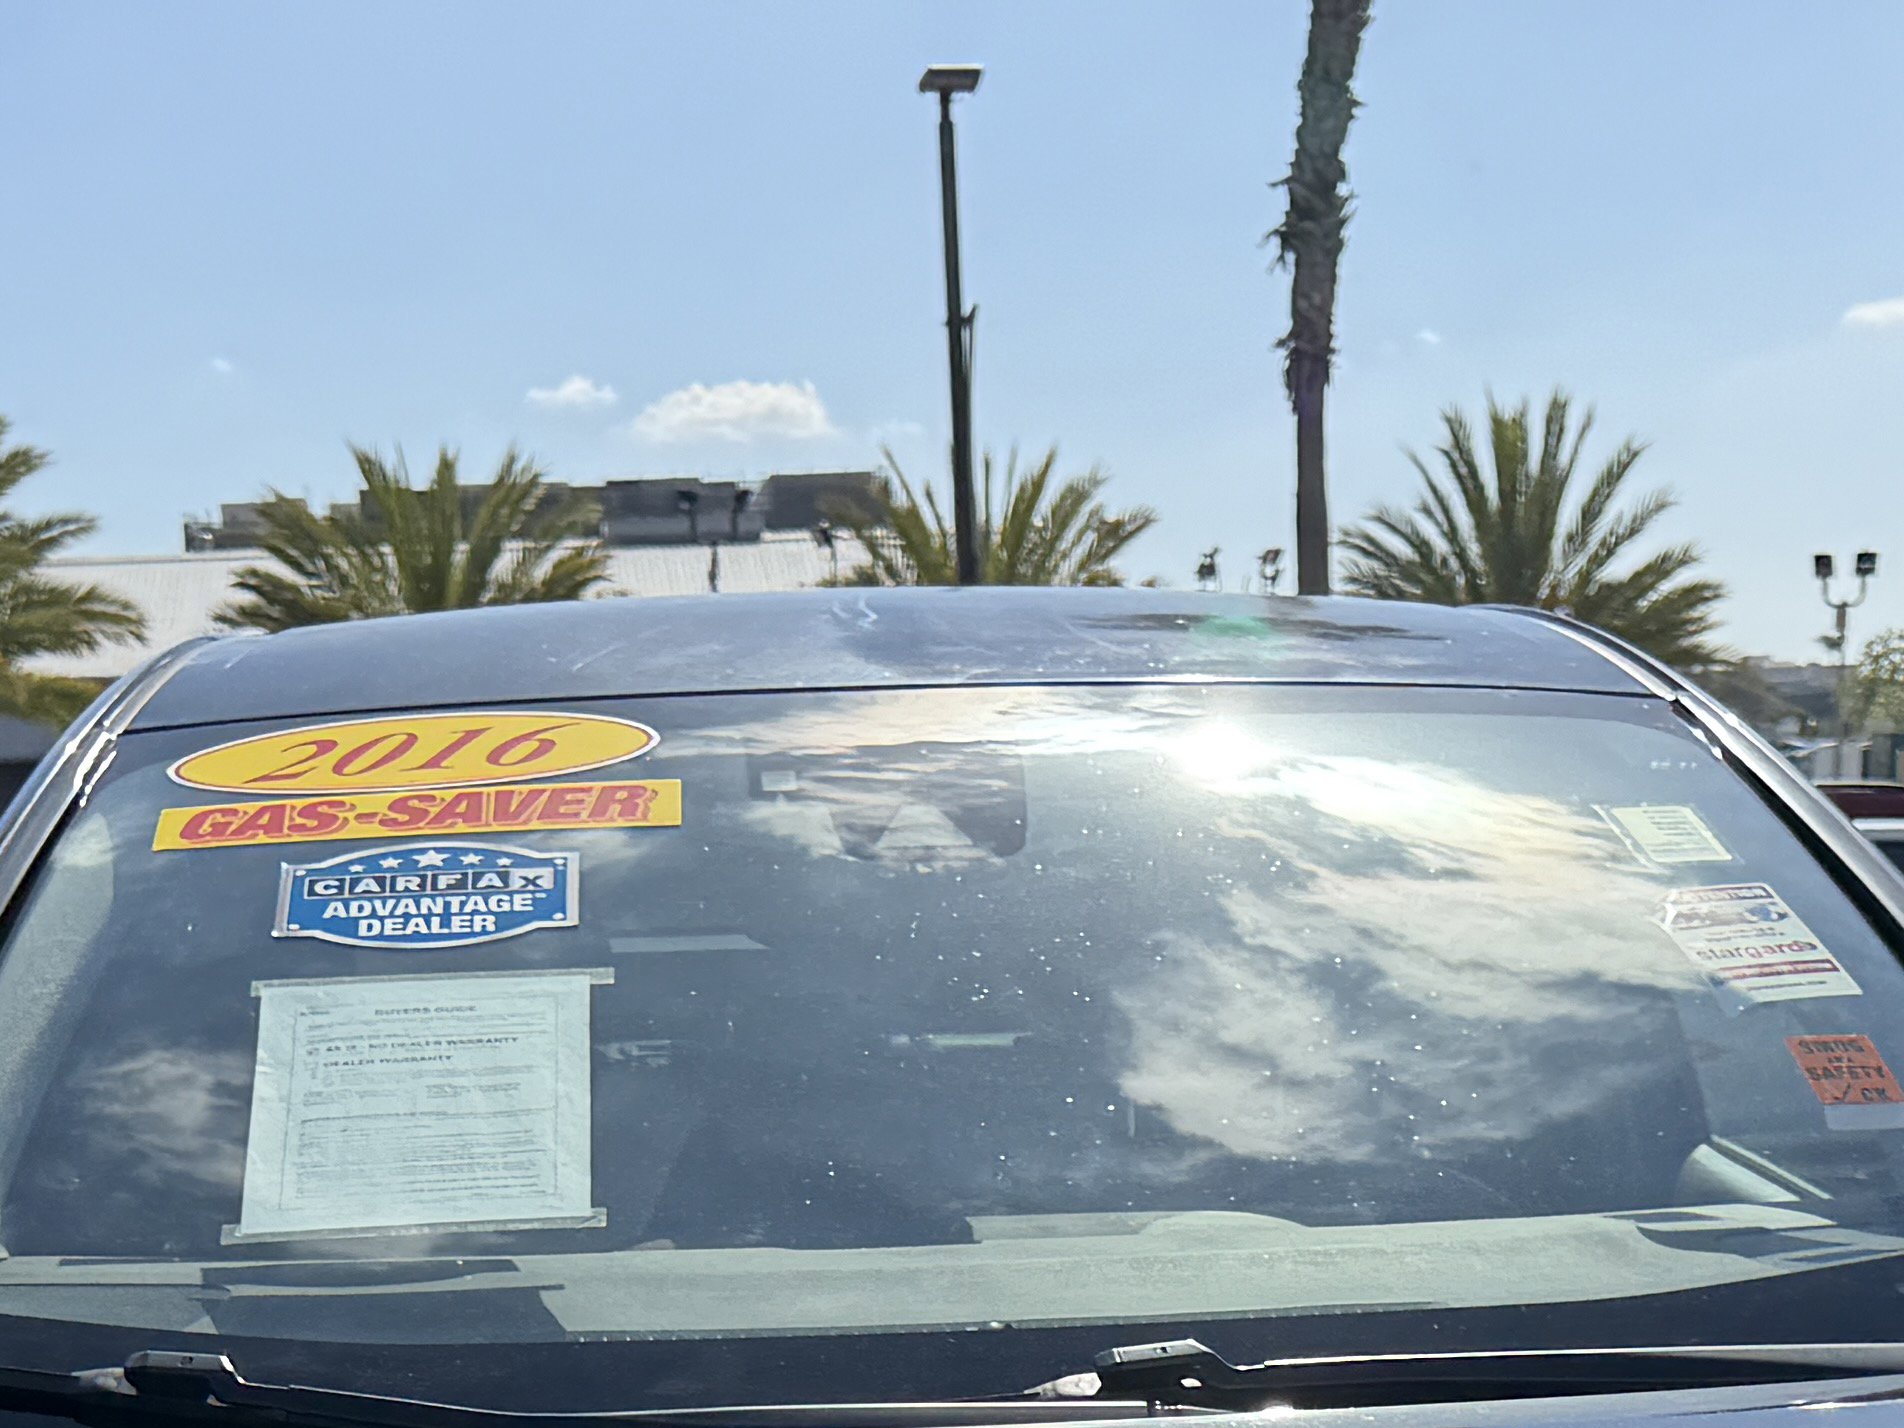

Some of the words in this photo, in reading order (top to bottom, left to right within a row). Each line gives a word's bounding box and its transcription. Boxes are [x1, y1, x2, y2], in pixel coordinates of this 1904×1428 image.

[244, 722, 583, 785] 2016
[178, 784, 660, 845] GAS-SAVER
[309, 871, 549, 897] CARFAX
[322, 894, 536, 919] ADVANTAGE
[357, 914, 496, 937] DEALER
